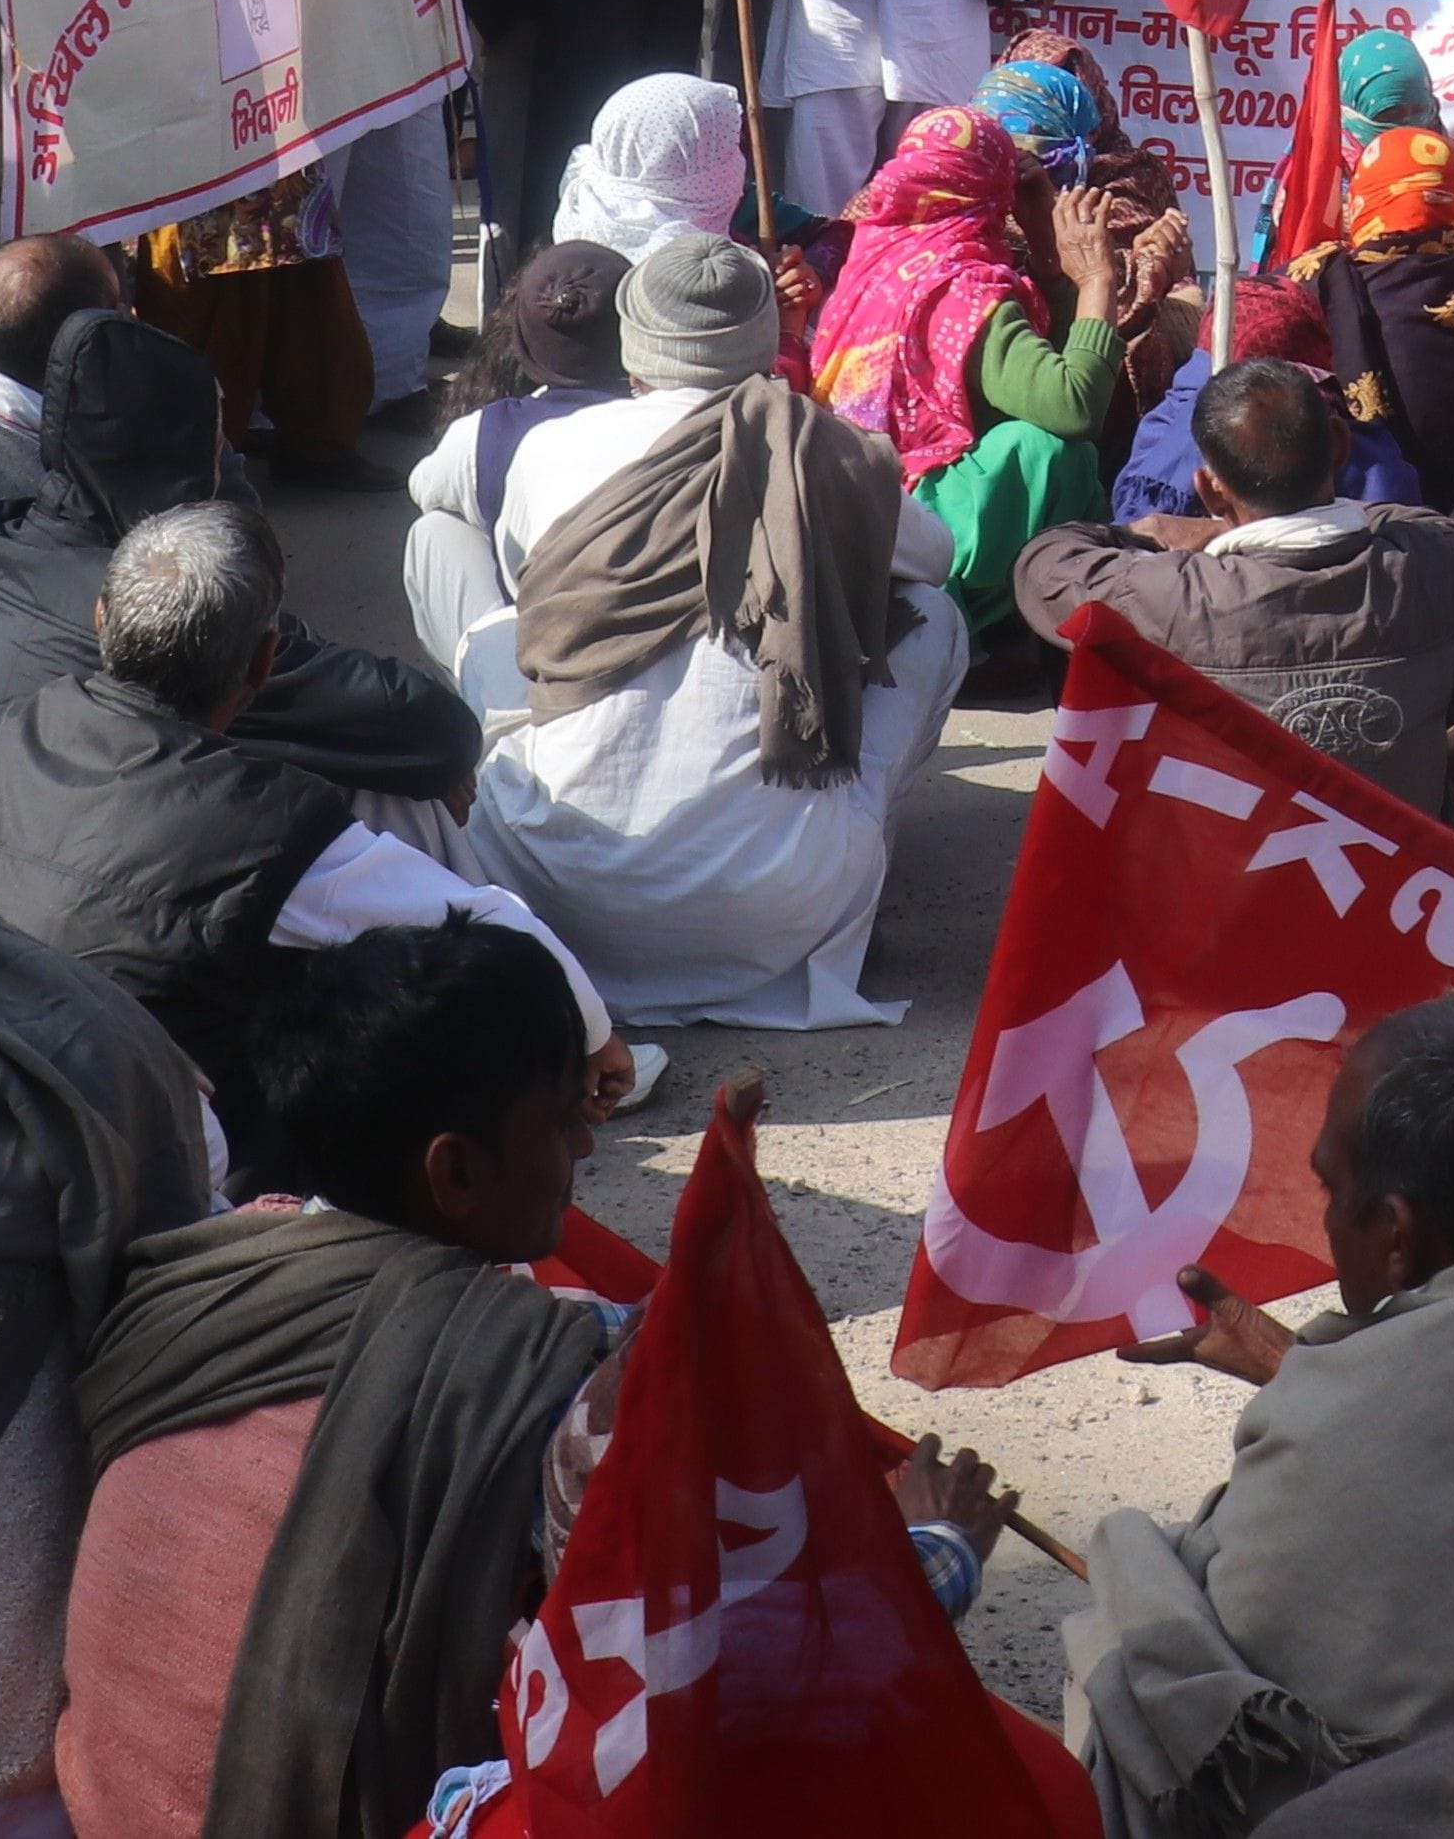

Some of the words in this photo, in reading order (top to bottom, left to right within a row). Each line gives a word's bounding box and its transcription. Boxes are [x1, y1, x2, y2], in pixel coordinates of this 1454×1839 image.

[231, 66, 298, 152] भिवानी
[1119, 64, 1203, 124] बिल
[1217, 87, 1298, 128] 2020
